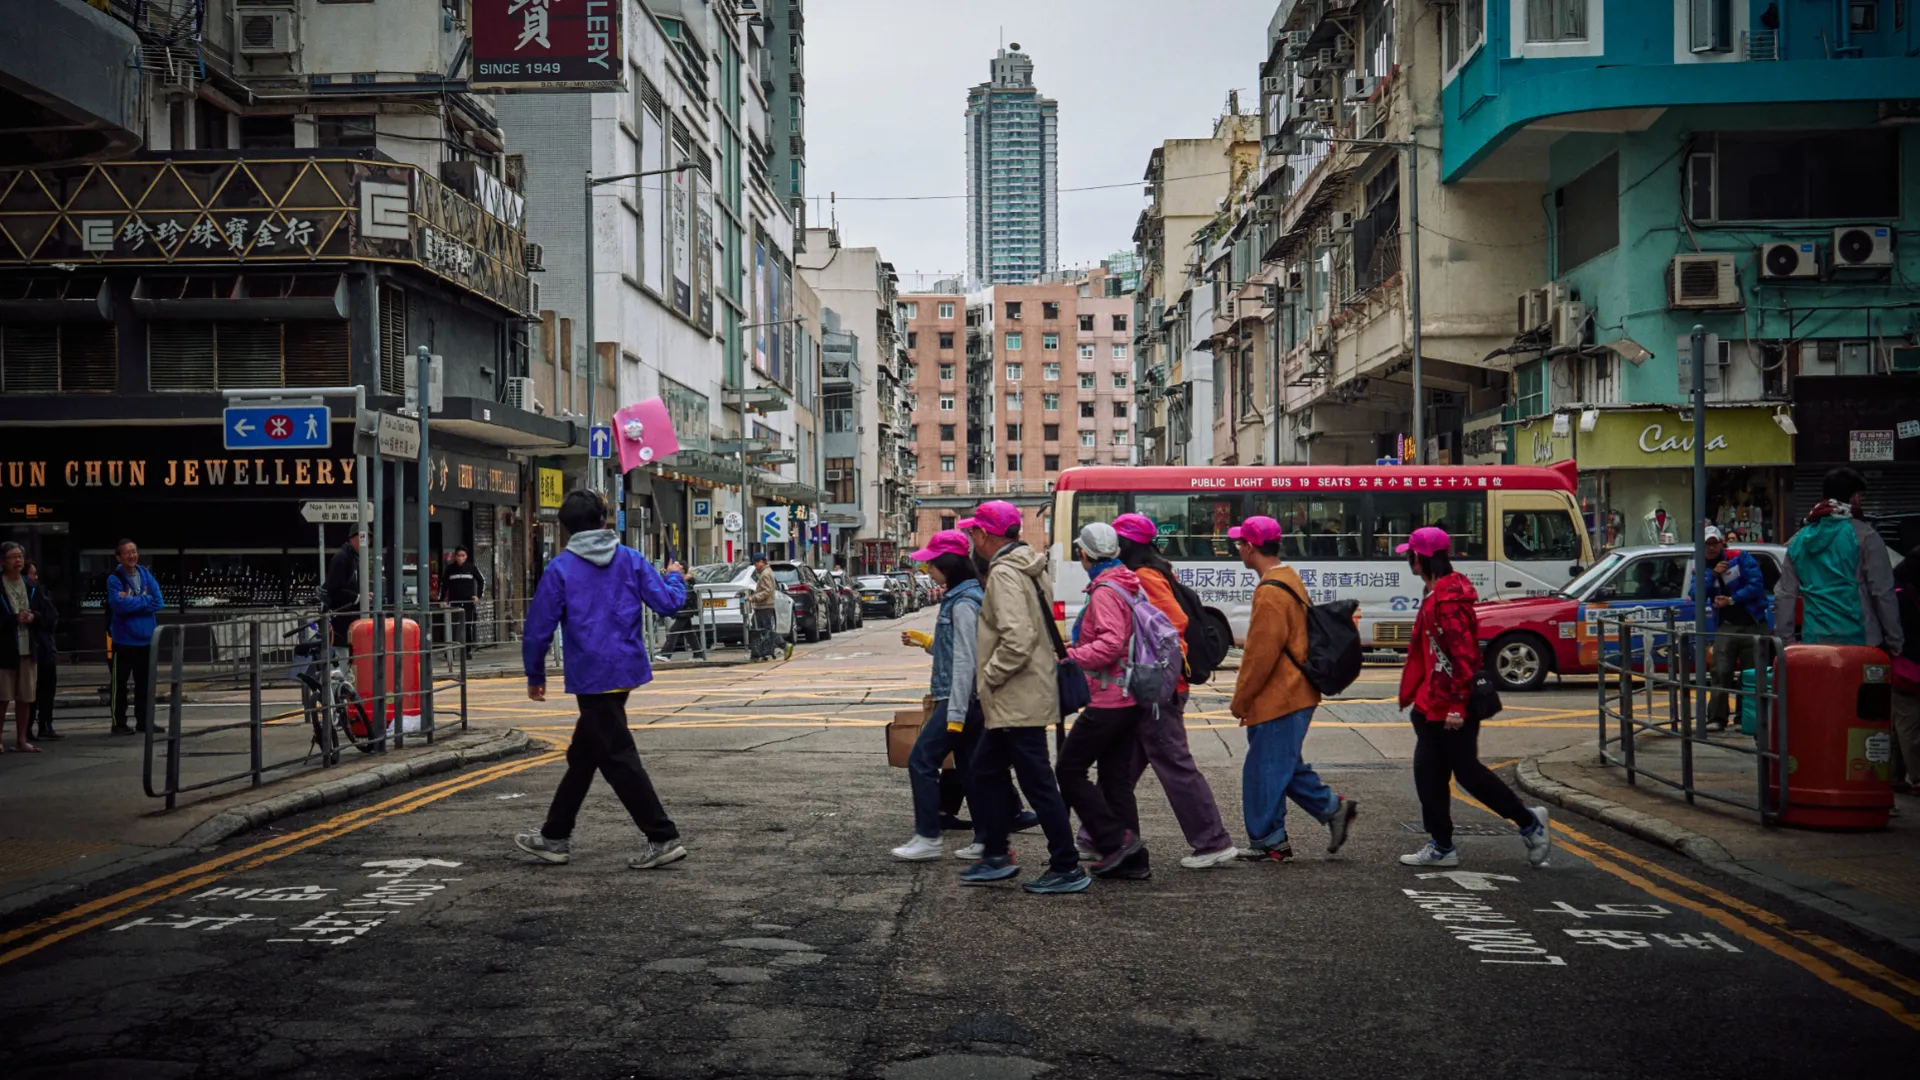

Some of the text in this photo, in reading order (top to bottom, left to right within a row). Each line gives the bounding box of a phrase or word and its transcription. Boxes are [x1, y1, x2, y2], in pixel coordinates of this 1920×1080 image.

[479, 63, 561, 75] SINCE 1949
[122, 217, 315, 251] 珍珍珠寶金行
[1639, 424, 1728, 453] Cava
[0, 458, 356, 487] UN CHUN JEWELLERY
[1191, 477, 1226, 487] PUBLIC
[1234, 477, 1263, 487] LIGHT
[1271, 477, 1291, 487] BUS
[1300, 477, 1310, 487] 19
[1318, 477, 1351, 487] SEATS
[1322, 572, 1400, 588] 篩查和治理
[1402, 888, 1567, 966] LOOK RIGHT
